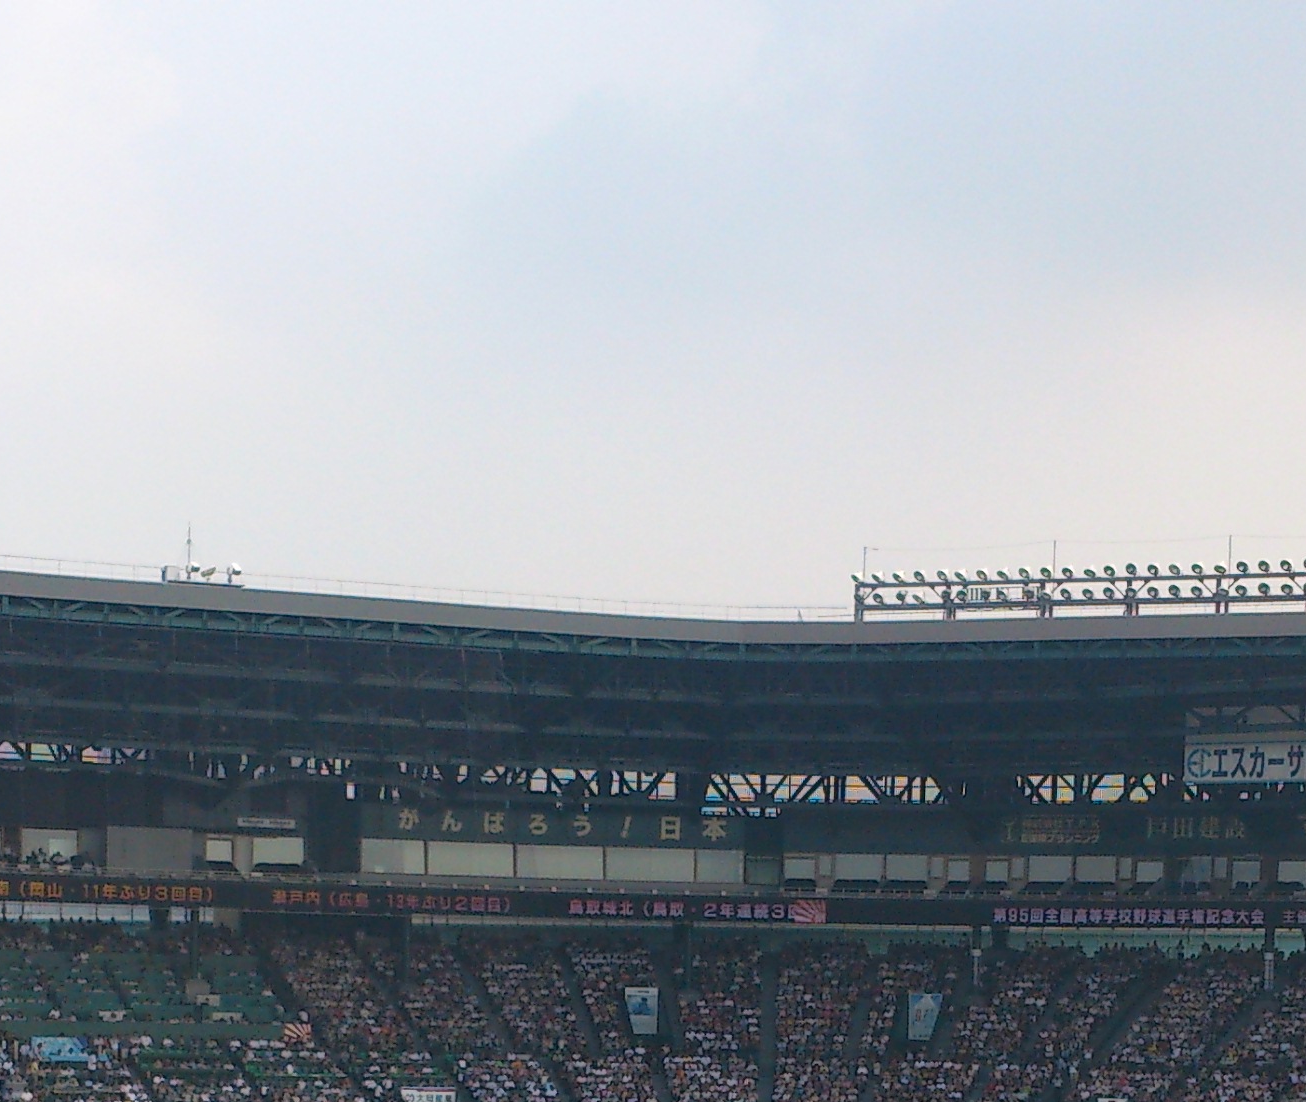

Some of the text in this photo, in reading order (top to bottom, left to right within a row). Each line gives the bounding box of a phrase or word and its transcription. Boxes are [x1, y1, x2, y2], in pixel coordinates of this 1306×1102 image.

[1213, 745, 1304, 778] エスカーサ
